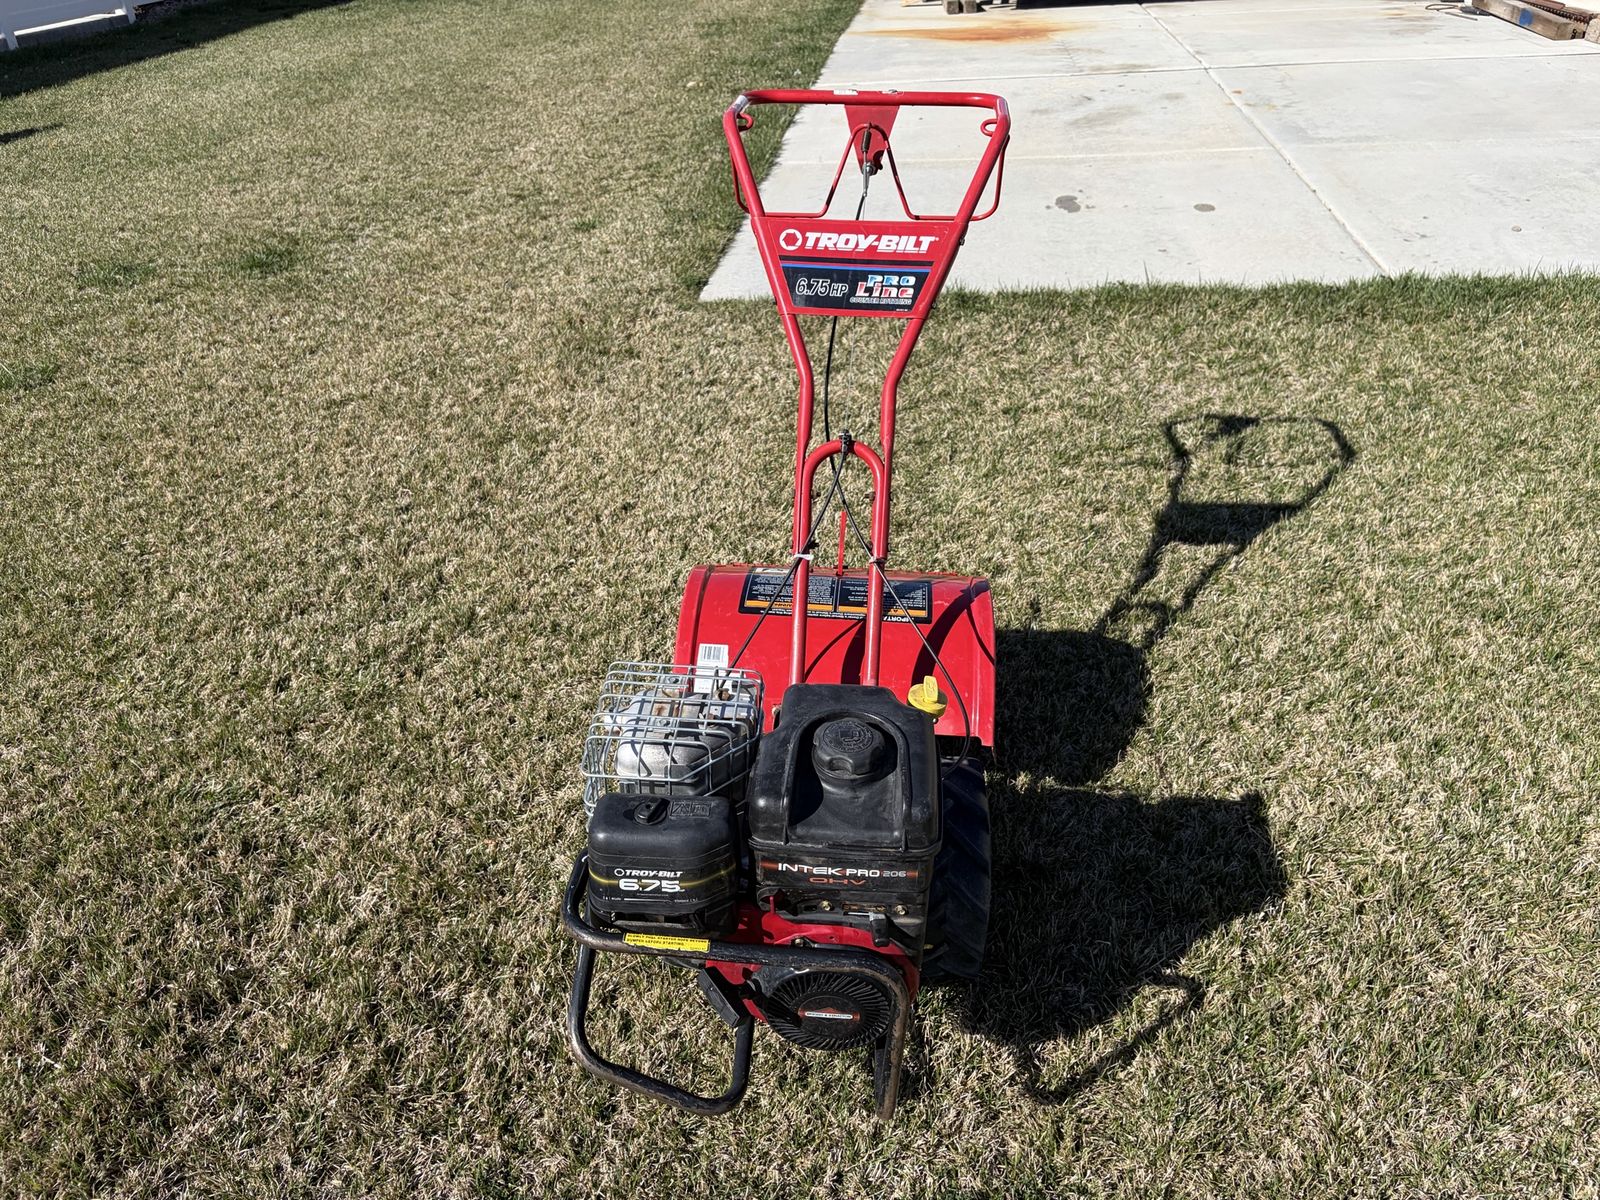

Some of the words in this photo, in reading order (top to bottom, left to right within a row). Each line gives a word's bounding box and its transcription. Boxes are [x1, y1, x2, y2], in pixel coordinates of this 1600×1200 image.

[805, 231, 936, 254] TROY-BILT
[795, 277, 830, 297] 6.75
[830, 282, 849, 297] HP
[866, 274, 916, 287] PRO
[855, 281, 915, 298] Line
[624, 869, 683, 878] TROY-BILT
[777, 862, 844, 876] INTEK
[845, 868, 880, 877] PRO
[882, 870, 906, 878] 206
[619, 878, 681, 893] 6.75
[809, 877, 866, 886] OHV
